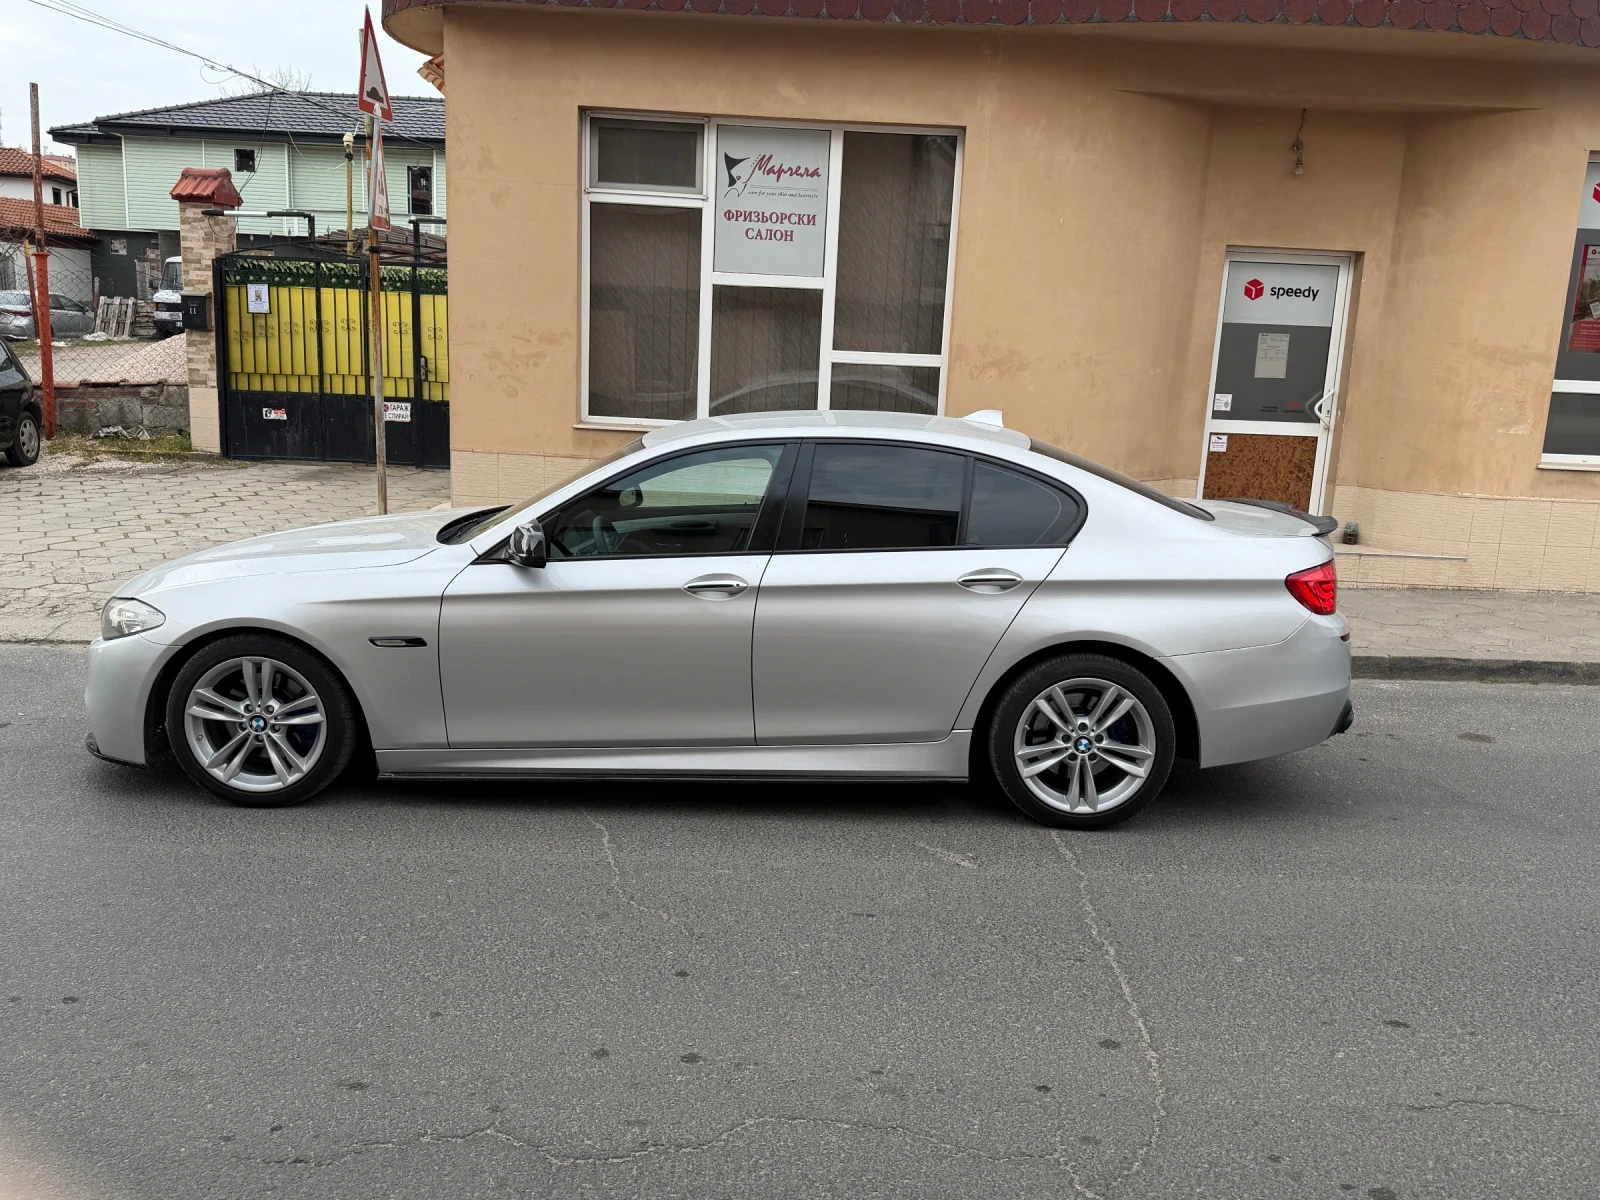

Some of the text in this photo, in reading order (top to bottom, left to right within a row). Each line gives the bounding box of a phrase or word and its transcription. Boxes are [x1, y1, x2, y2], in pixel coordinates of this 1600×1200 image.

[723, 209, 817, 226] ФРИЗЬОРСКИ
[744, 227, 794, 242] САЛОН
[1270, 285, 1320, 302] speedy
[390, 404, 409, 412] ГАРАЖ
